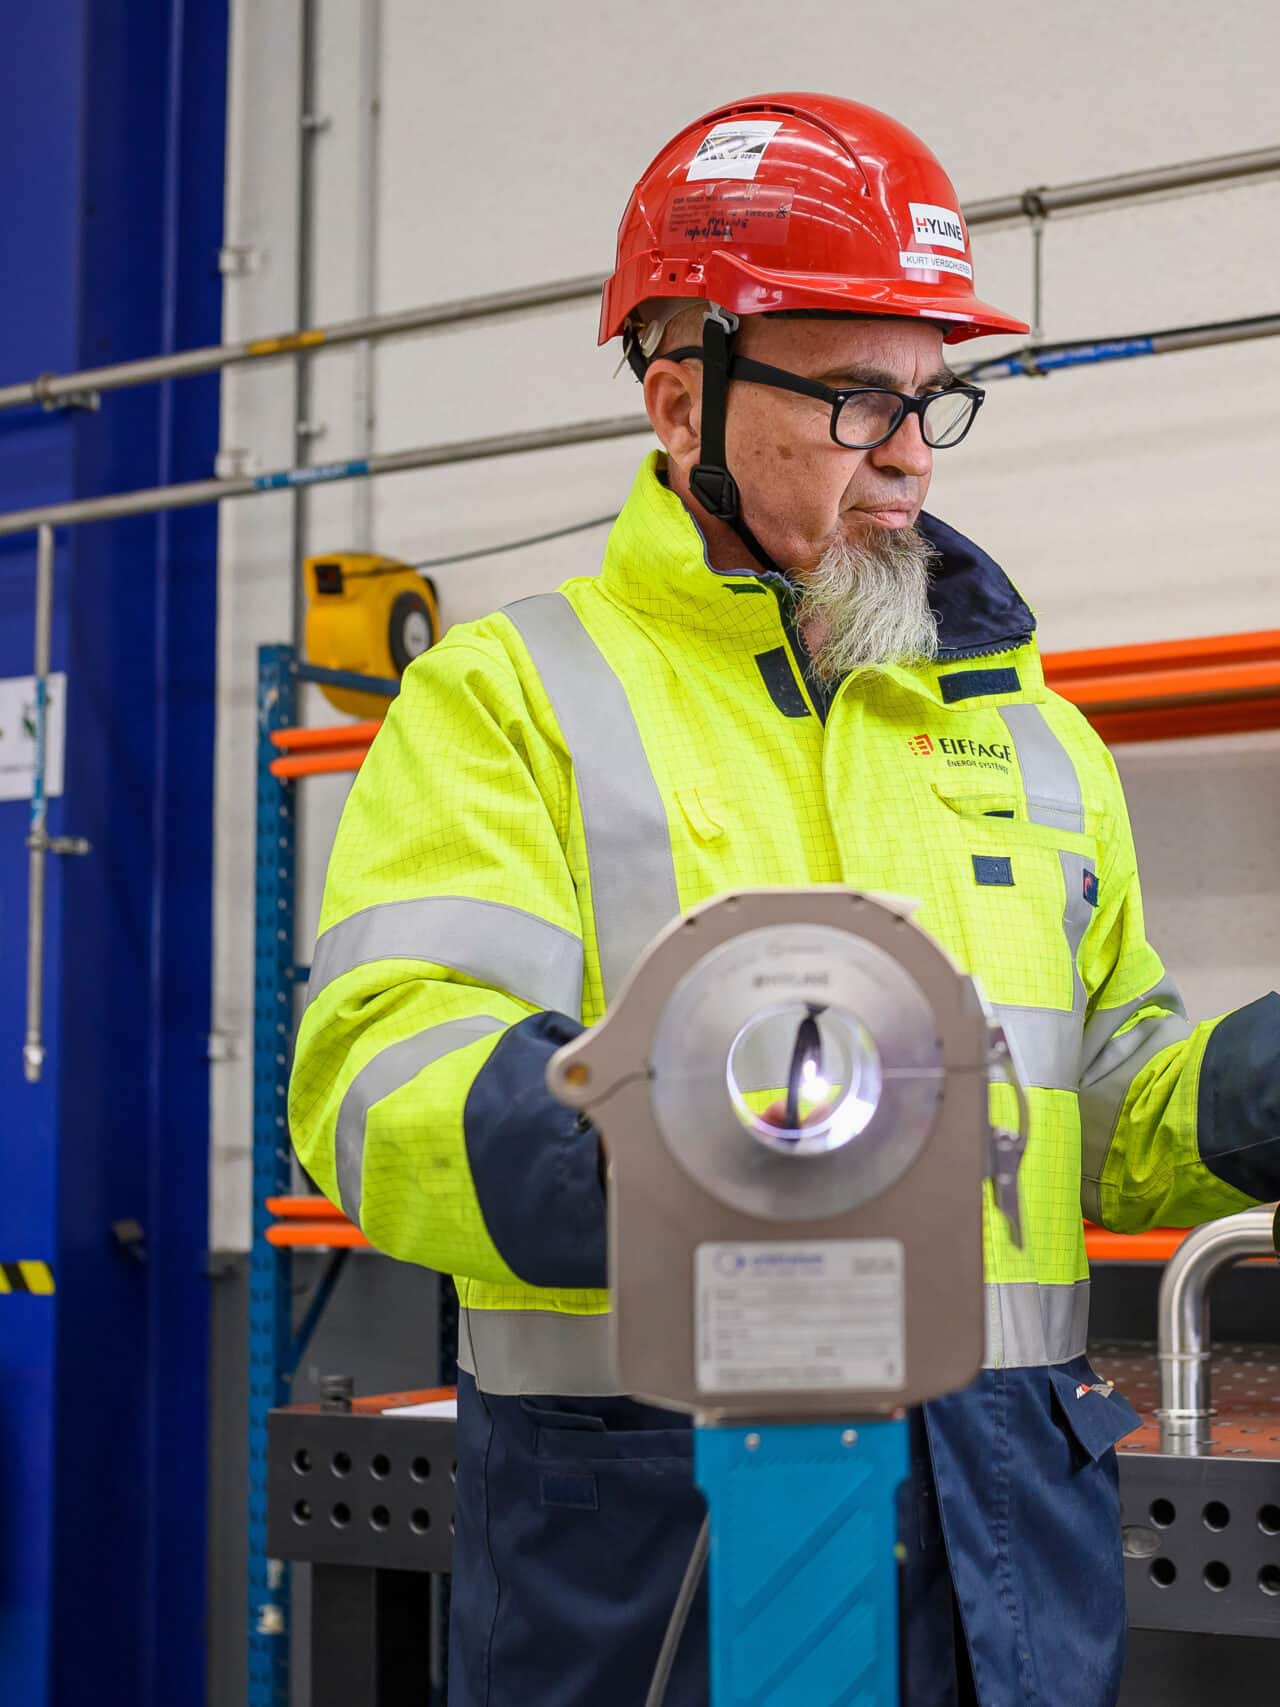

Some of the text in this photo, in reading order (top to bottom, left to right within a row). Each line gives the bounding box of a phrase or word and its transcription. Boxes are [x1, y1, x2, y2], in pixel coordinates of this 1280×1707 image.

[915, 216, 962, 241] HYLINE
[906, 255, 929, 265] KURT
[938, 738, 1013, 764] EIFFAGE
